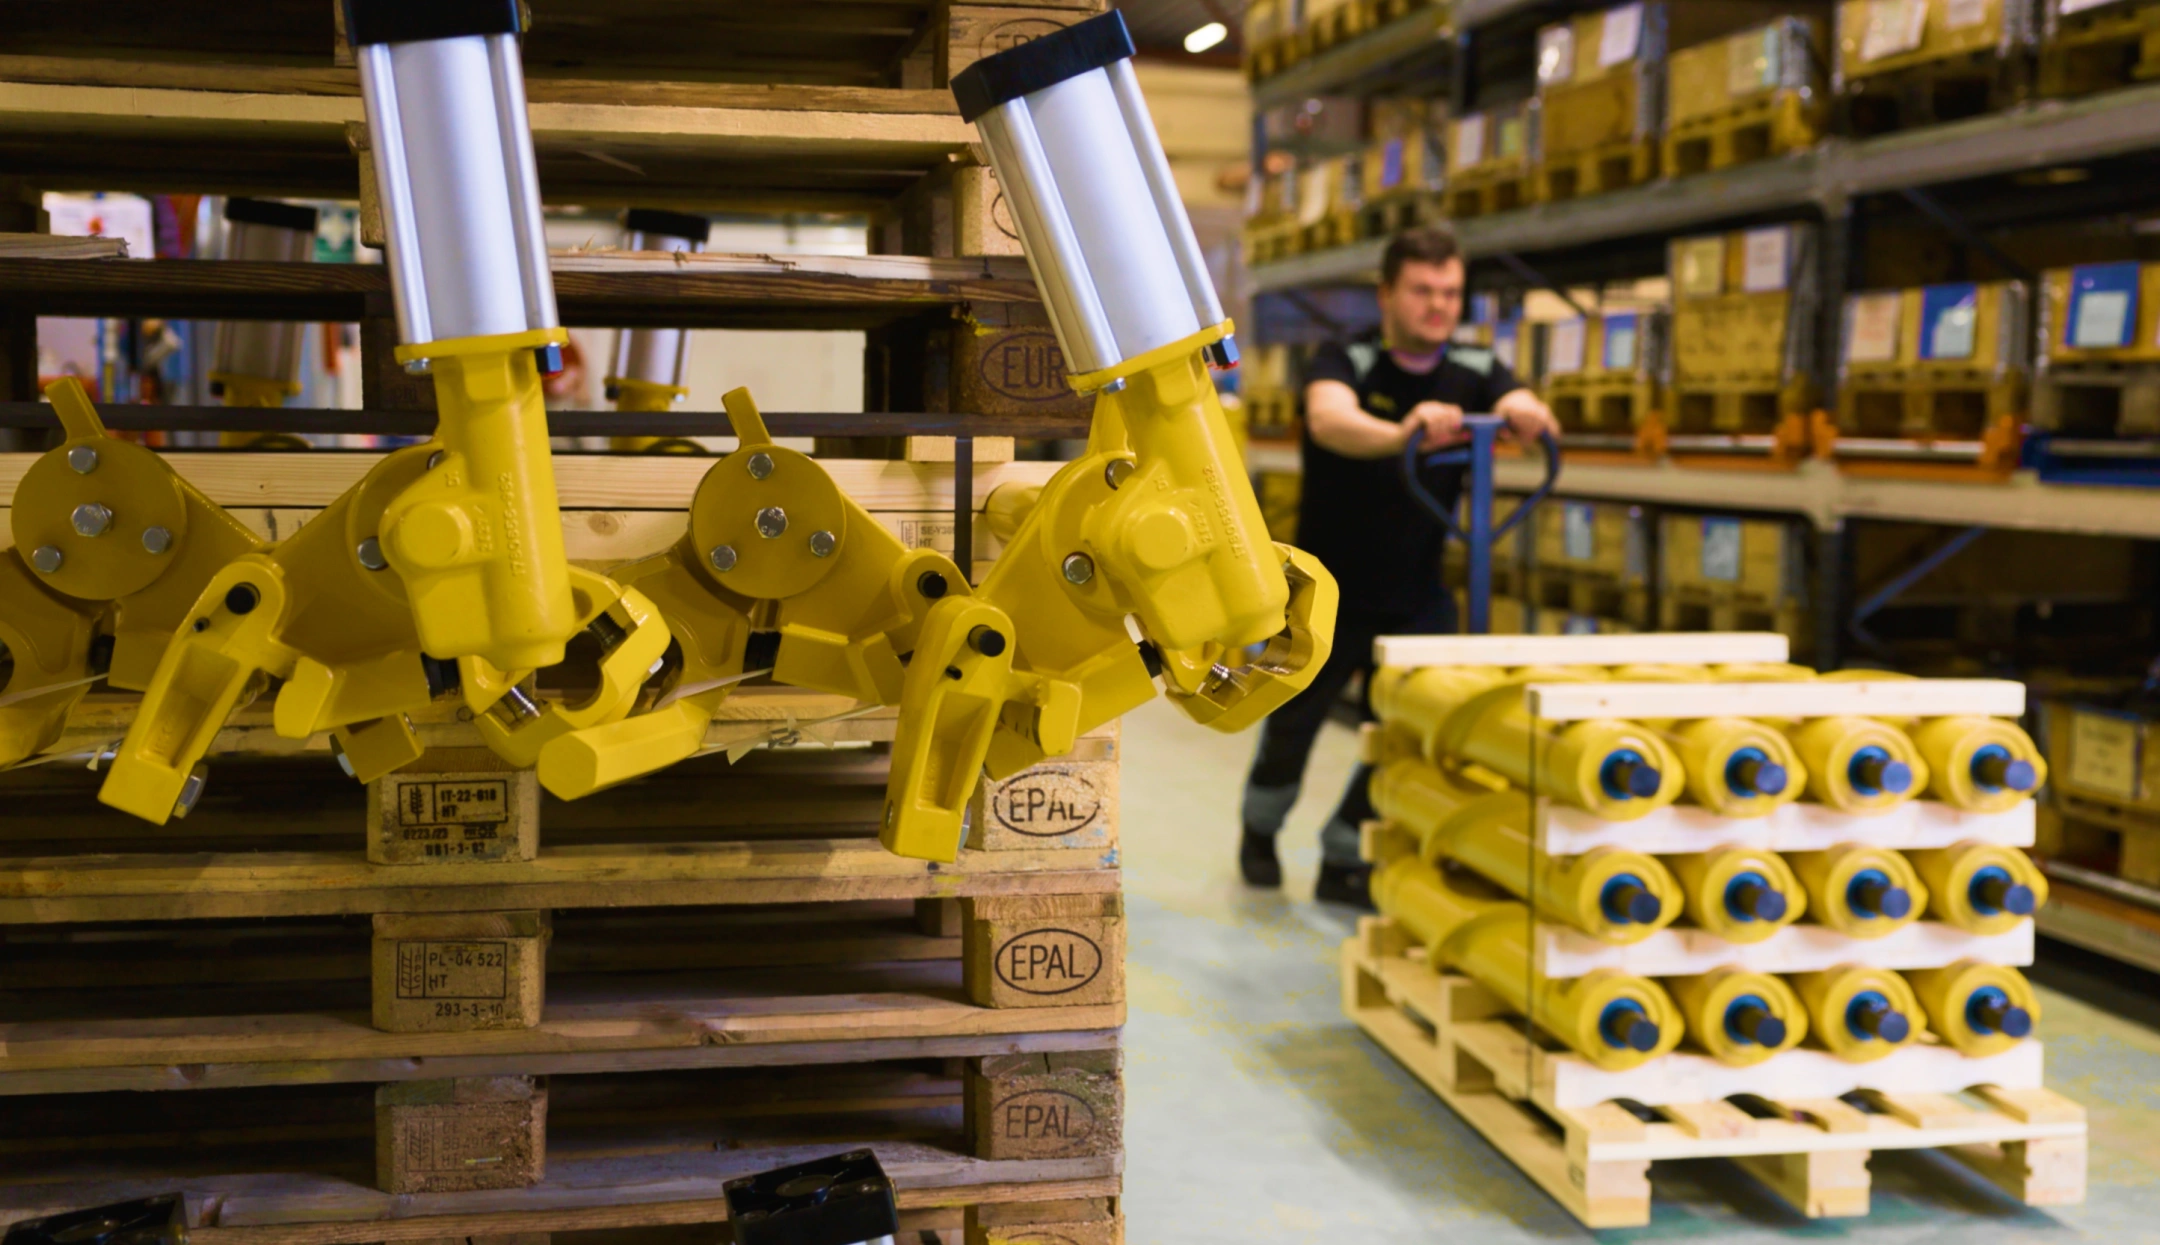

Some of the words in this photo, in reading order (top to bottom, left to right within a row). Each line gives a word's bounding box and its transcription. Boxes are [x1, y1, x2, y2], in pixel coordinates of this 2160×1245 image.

[1003, 346, 1065, 389] EUR
[919, 538, 932, 548] HT
[441, 805, 457, 818] HT
[1009, 787, 1086, 822] EPAL
[1011, 944, 1086, 980] EPAL
[429, 974, 448, 988] HT
[1006, 1104, 1080, 1138] EPAL
